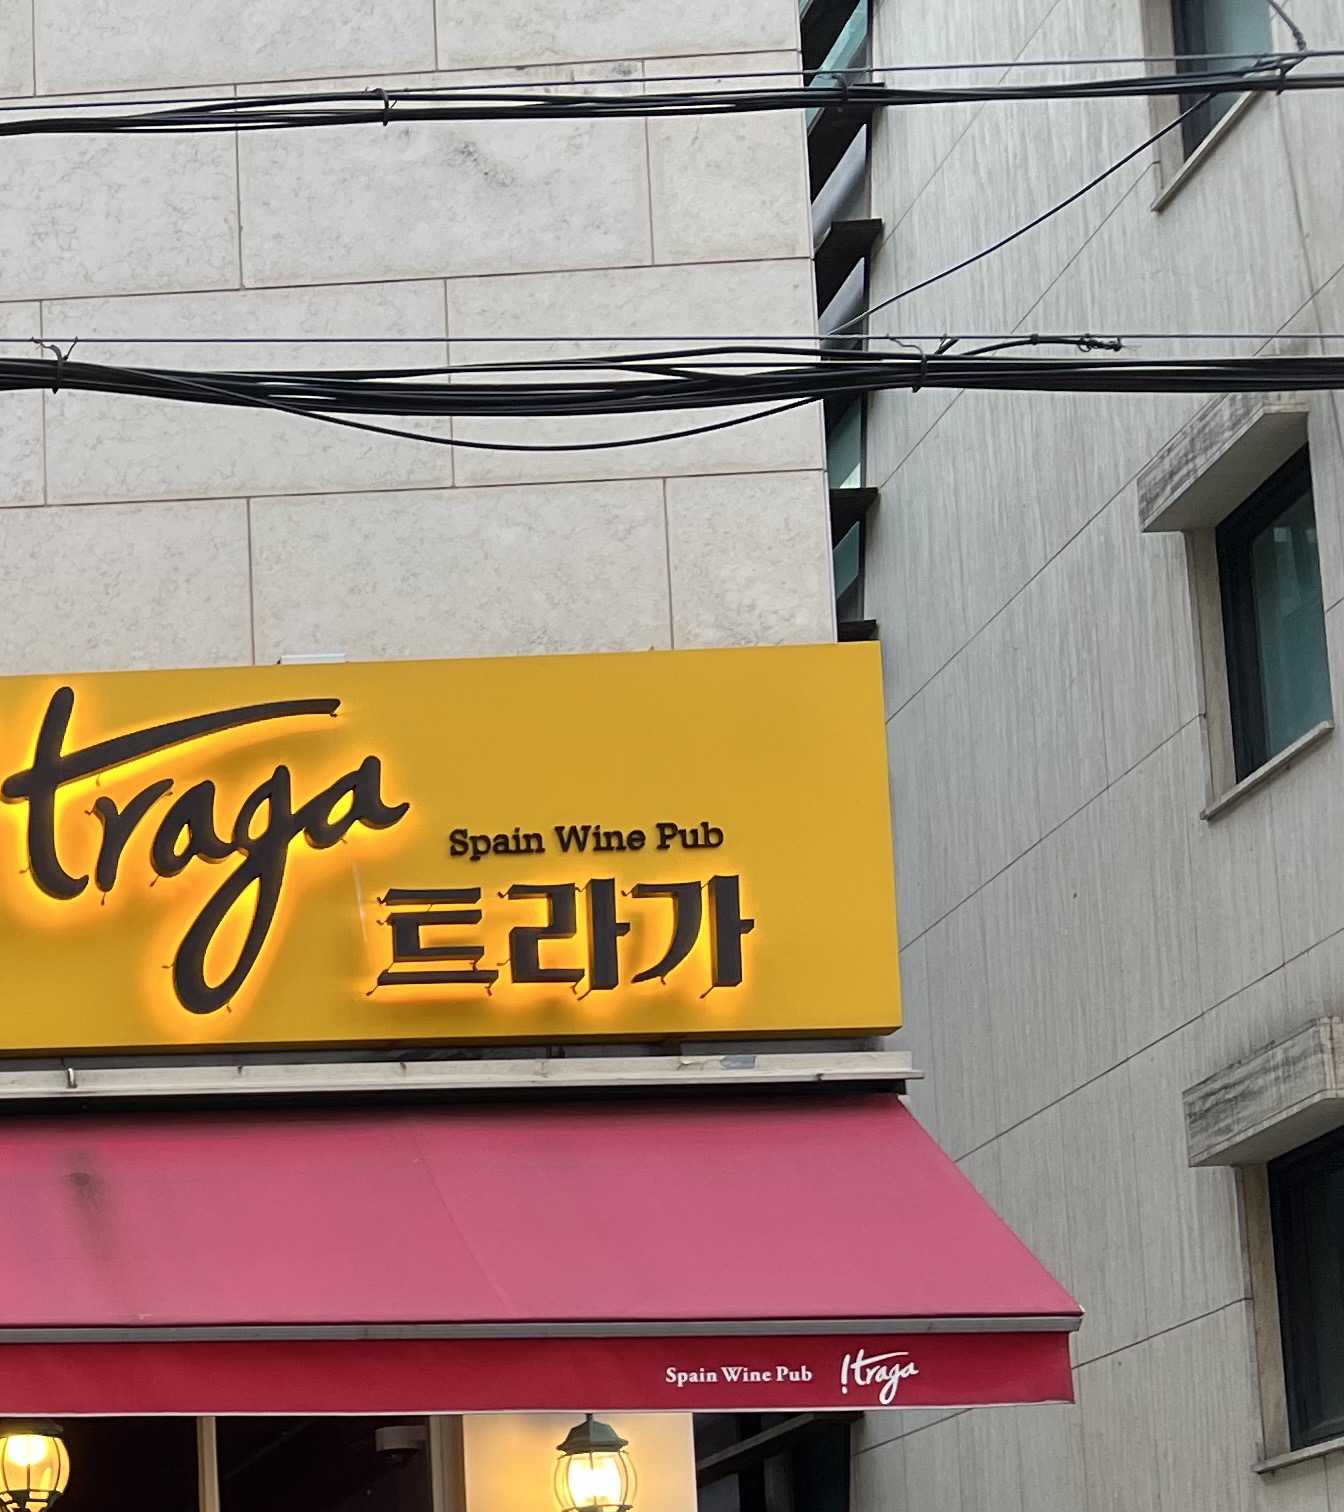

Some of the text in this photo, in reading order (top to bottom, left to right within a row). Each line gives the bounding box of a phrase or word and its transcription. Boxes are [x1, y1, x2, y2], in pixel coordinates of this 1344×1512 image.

[447, 821, 725, 861] Spain Wine Pub
[375, 874, 755, 992] 트라가
[665, 1366, 812, 1387] Spain Wine Pub
